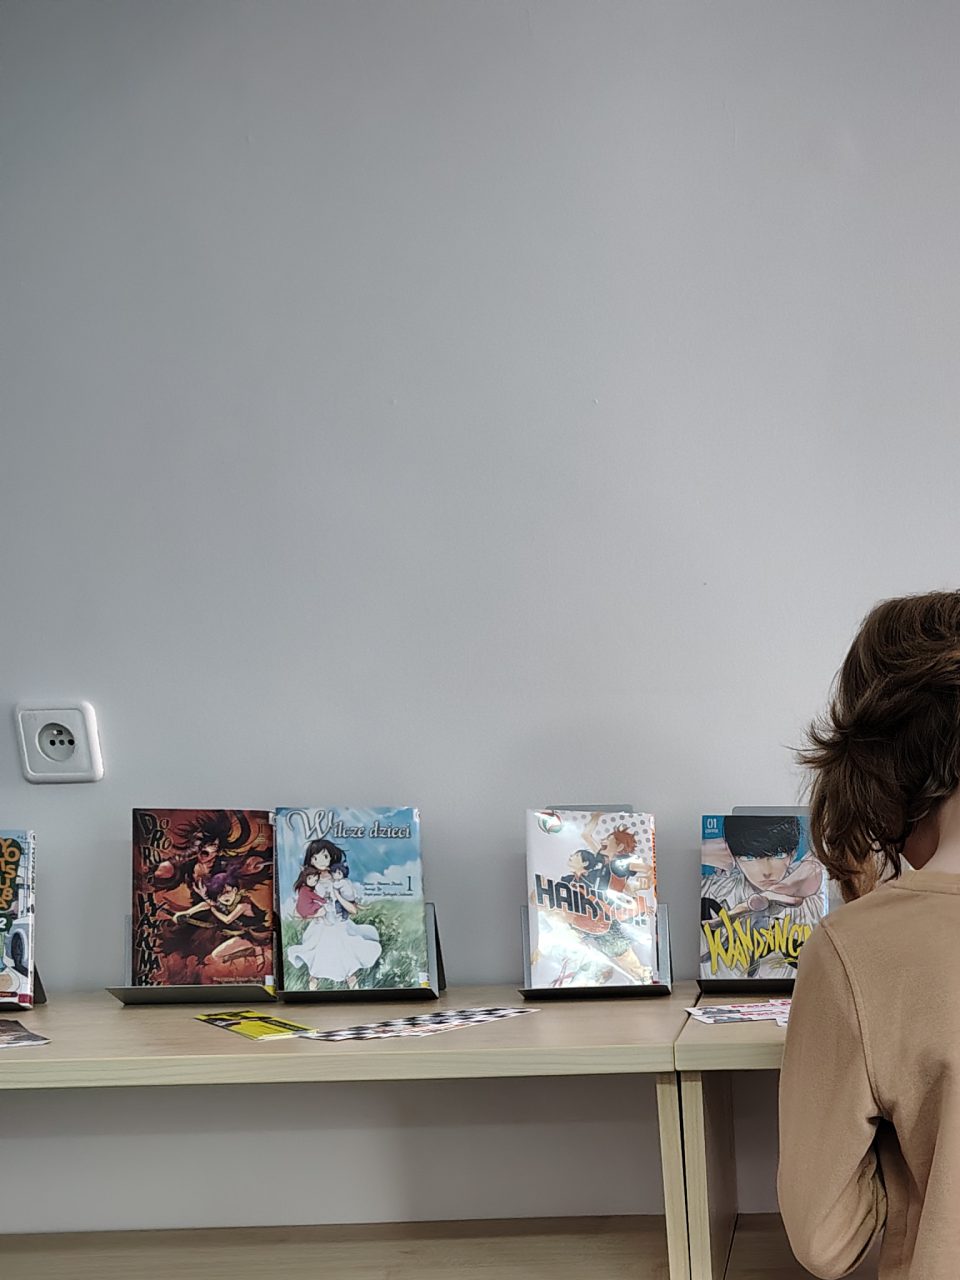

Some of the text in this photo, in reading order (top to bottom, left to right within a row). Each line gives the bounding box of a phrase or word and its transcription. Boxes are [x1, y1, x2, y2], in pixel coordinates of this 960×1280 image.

[286, 809, 366, 840] Wilcze
[369, 819, 411, 839] dzieci
[706, 818, 717, 829] 01
[406, 875, 413, 892] 1
